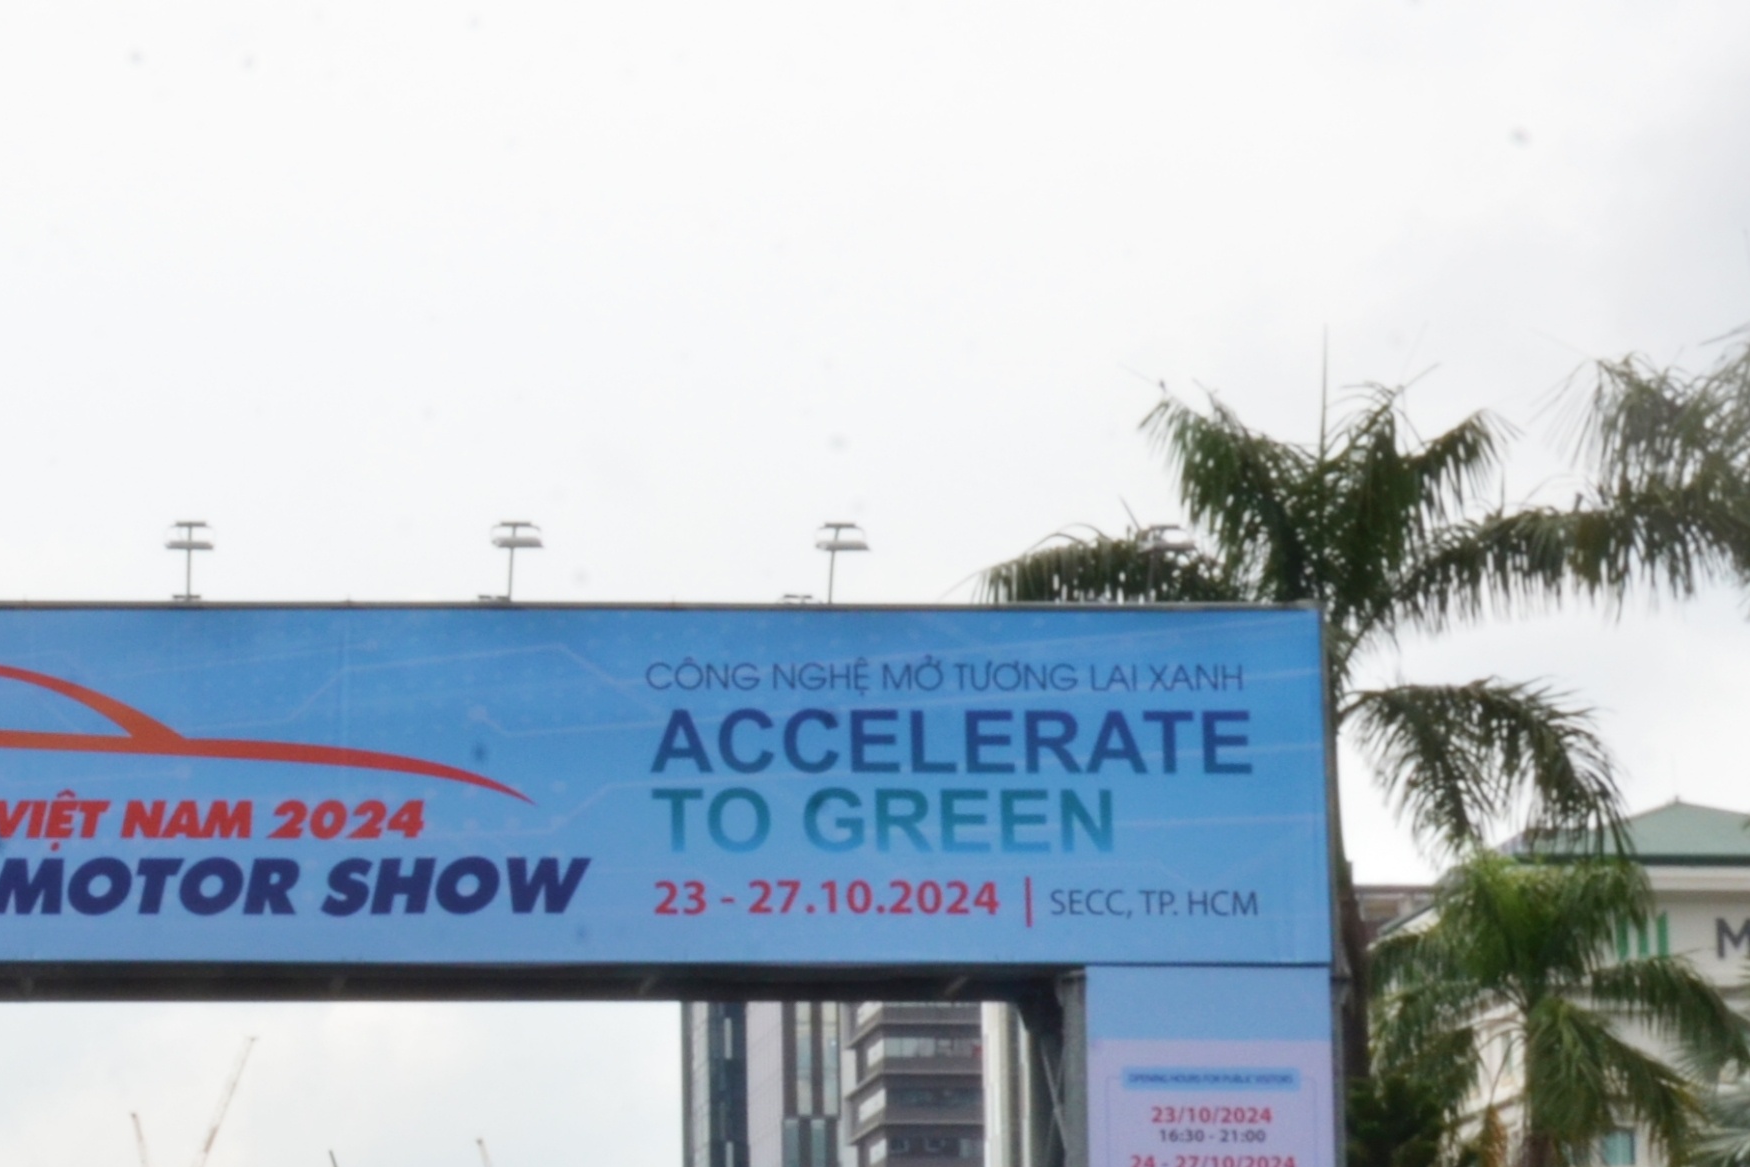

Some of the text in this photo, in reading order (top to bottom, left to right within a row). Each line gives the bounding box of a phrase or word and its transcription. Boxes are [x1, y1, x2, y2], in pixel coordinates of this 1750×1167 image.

[645, 654, 1245, 697] CÔNG NGHỆ MỞ TƯƠNG LAI XANH
[650, 707, 1253, 775] ACCELERATE
[120, 799, 254, 839] NAM
[266, 799, 425, 839] 2024
[652, 786, 1114, 853] TO GREEN
[320, 855, 592, 917] SHOW
[652, 880, 708, 916] 23
[746, 879, 1000, 917] 27.10.2024
[1049, 889, 1260, 920] SECC, TP. HCM
[1151, 1106, 1273, 1124] 23/10/2024
[1159, 1129, 1205, 1143] 16:30
[1219, 1129, 1266, 1143] 21:00
